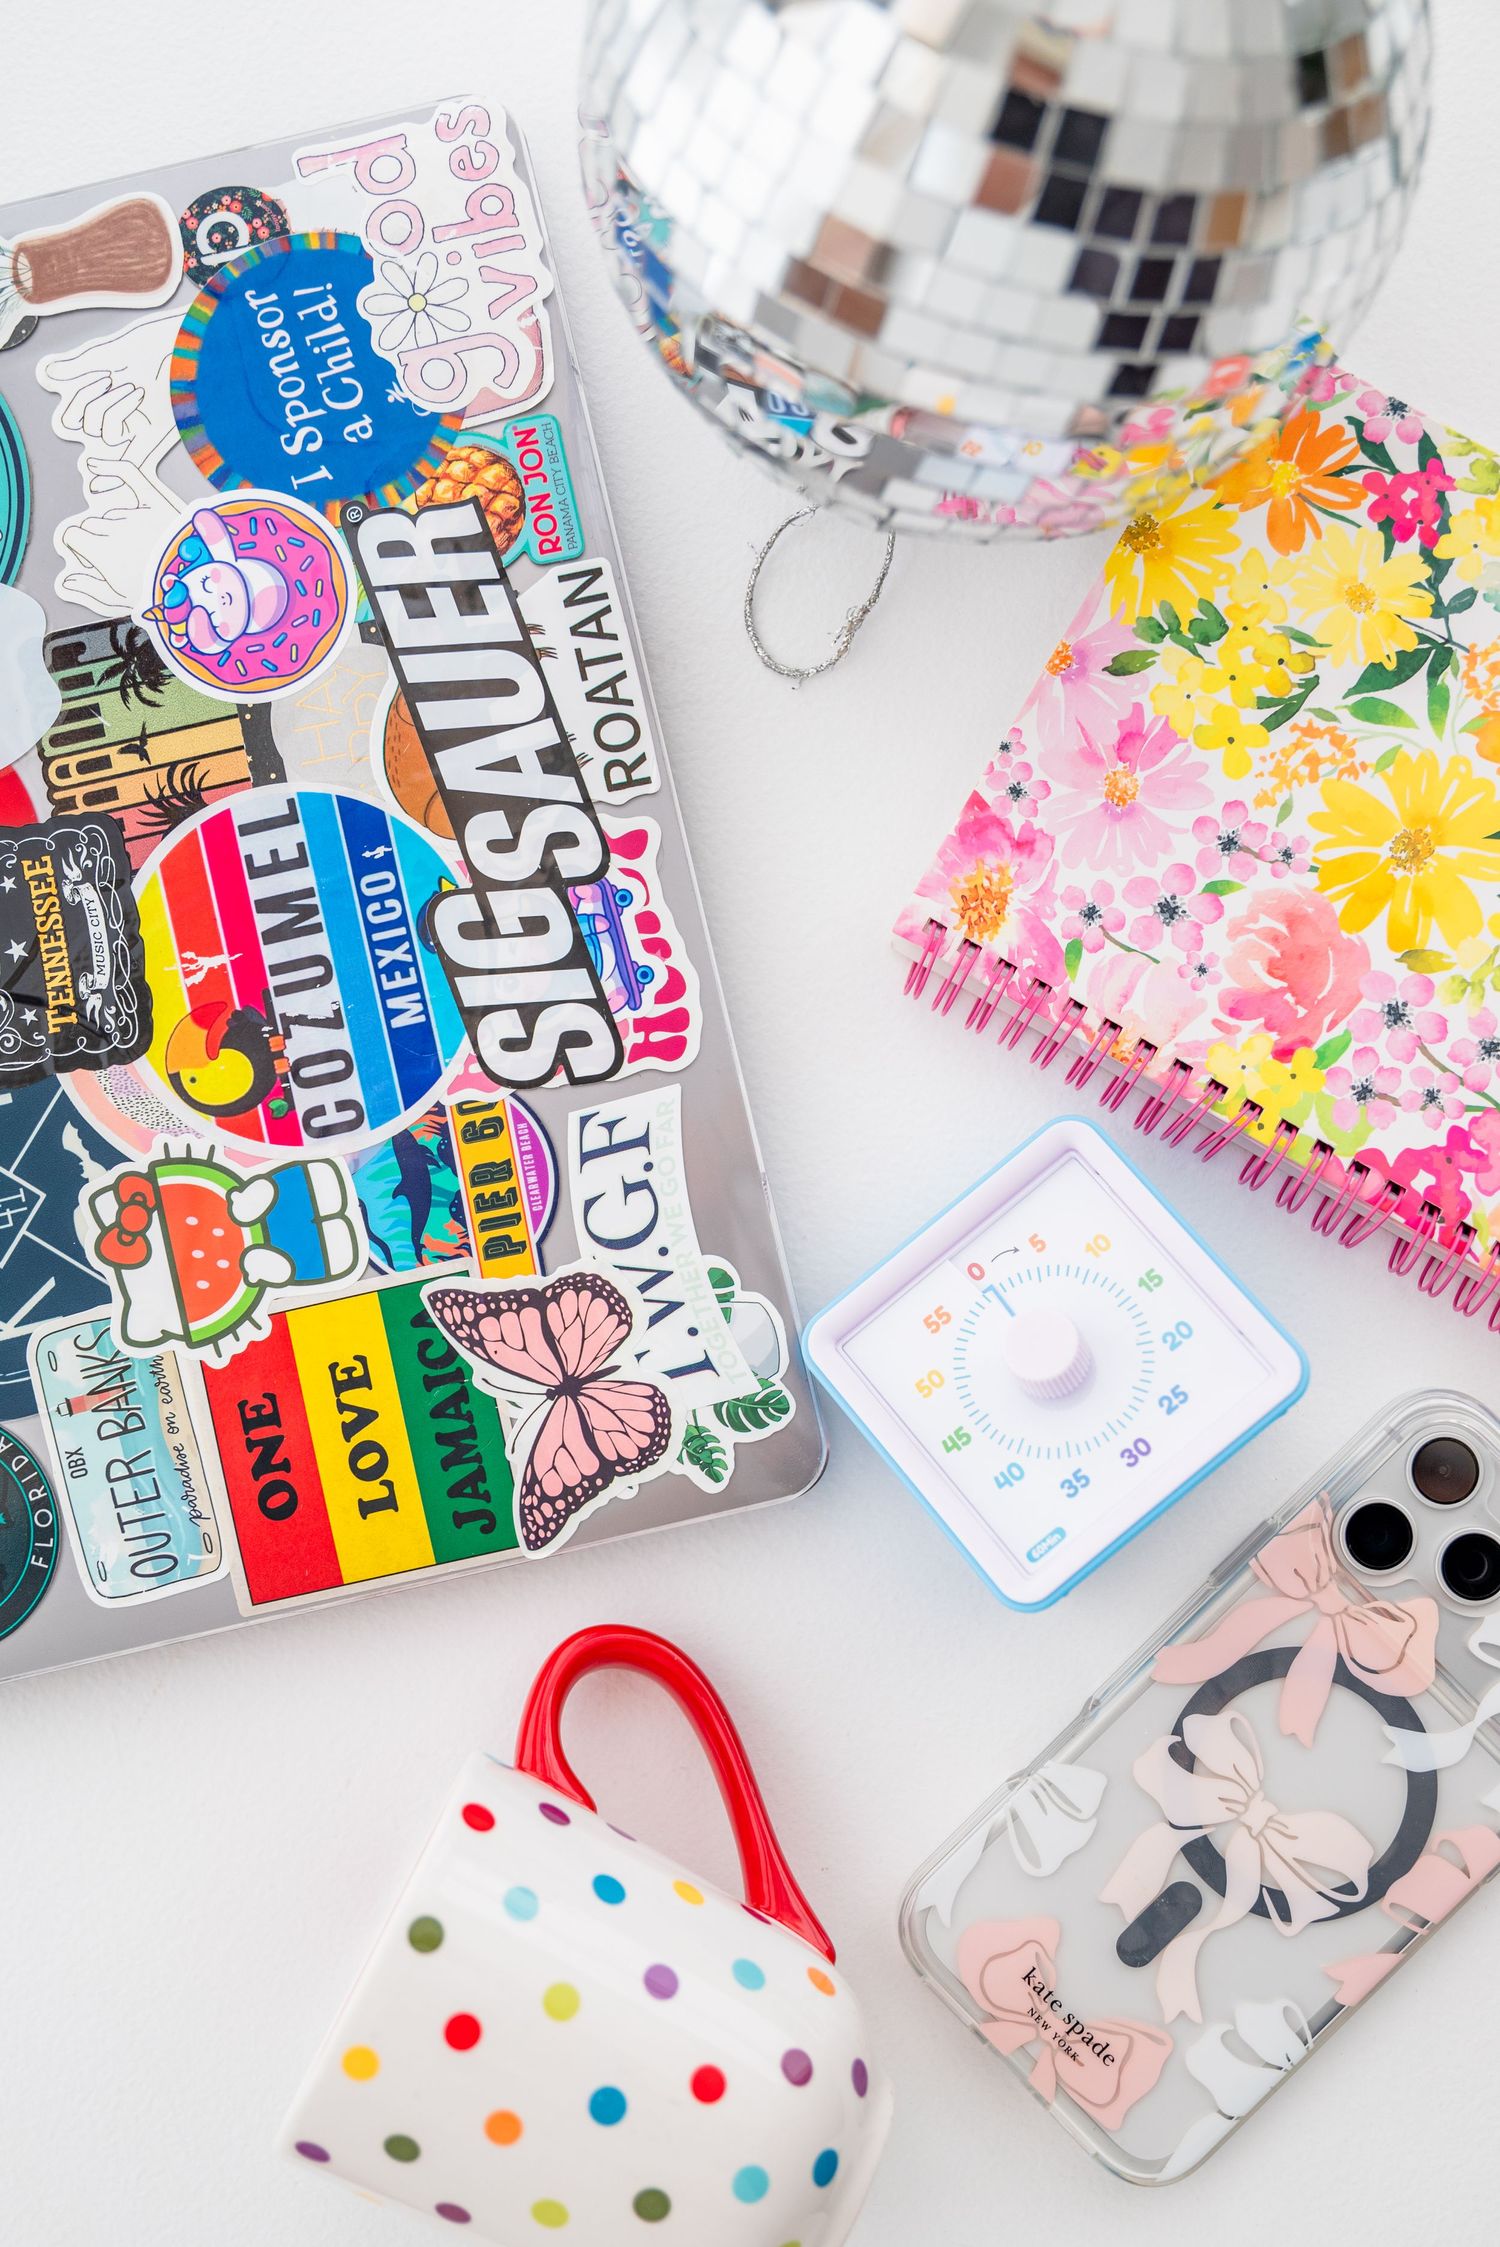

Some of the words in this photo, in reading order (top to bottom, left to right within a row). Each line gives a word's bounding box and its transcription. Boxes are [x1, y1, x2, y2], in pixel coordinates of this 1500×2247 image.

[432, 104, 538, 320] vibes
[293, 283, 363, 410] Child!
[244, 290, 327, 455] Sponsor
[343, 414, 373, 443] a
[541, 422, 559, 464] BEACH
[290, 465, 334, 490] I
[513, 427, 548, 485] JON
[551, 468, 566, 496] CITY
[528, 492, 563, 555] RON
[558, 497, 579, 550] PANAMA
[558, 566, 653, 792] ROATAN
[84, 898, 101, 928] CITY
[20, 855, 78, 1034] TENNESSEE
[92, 932, 106, 975] MUSIC
[359, 870, 426, 1029] MEXICO
[238, 797, 365, 1139] COZUMEL
[517, 1122, 531, 1151] BEACH
[656, 1097, 675, 1152] FAR
[522, 1154, 543, 1211] CLEARWATER
[657, 1155, 679, 1197] GO
[469, 1158, 527, 1261] PIER
[663, 1203, 688, 1247] WE
[1027, 1233, 1047, 1253] 5
[1084, 1233, 1112, 1258] 10
[967, 1262, 985, 1281] 0
[1138, 1268, 1164, 1293] 15
[672, 1252, 748, 1384] TOGETHER
[922, 1306, 952, 1334] 55
[1161, 1320, 1194, 1351] 20
[73, 1326, 146, 1441] BANKS
[915, 1369, 945, 1399] 50
[1157, 1384, 1190, 1416] 25
[165, 1411, 181, 1435] on
[328, 1354, 400, 1520] LOVE
[941, 1426, 972, 1455] 45
[66, 1447, 88, 1479] OBX
[238, 1392, 299, 1522] ONE
[1120, 1437, 1152, 1468] 30
[173, 1442, 211, 1527] paradise
[993, 1461, 1025, 1492] 40
[1059, 1468, 1091, 1499] 35
[106, 1449, 178, 1578] OUTER
[1021, 1966, 1063, 2012] kate
[1063, 2012, 1115, 2067] spade
[1027, 2007, 1051, 2031] NEW
[1052, 2032, 1079, 2061] YORK
